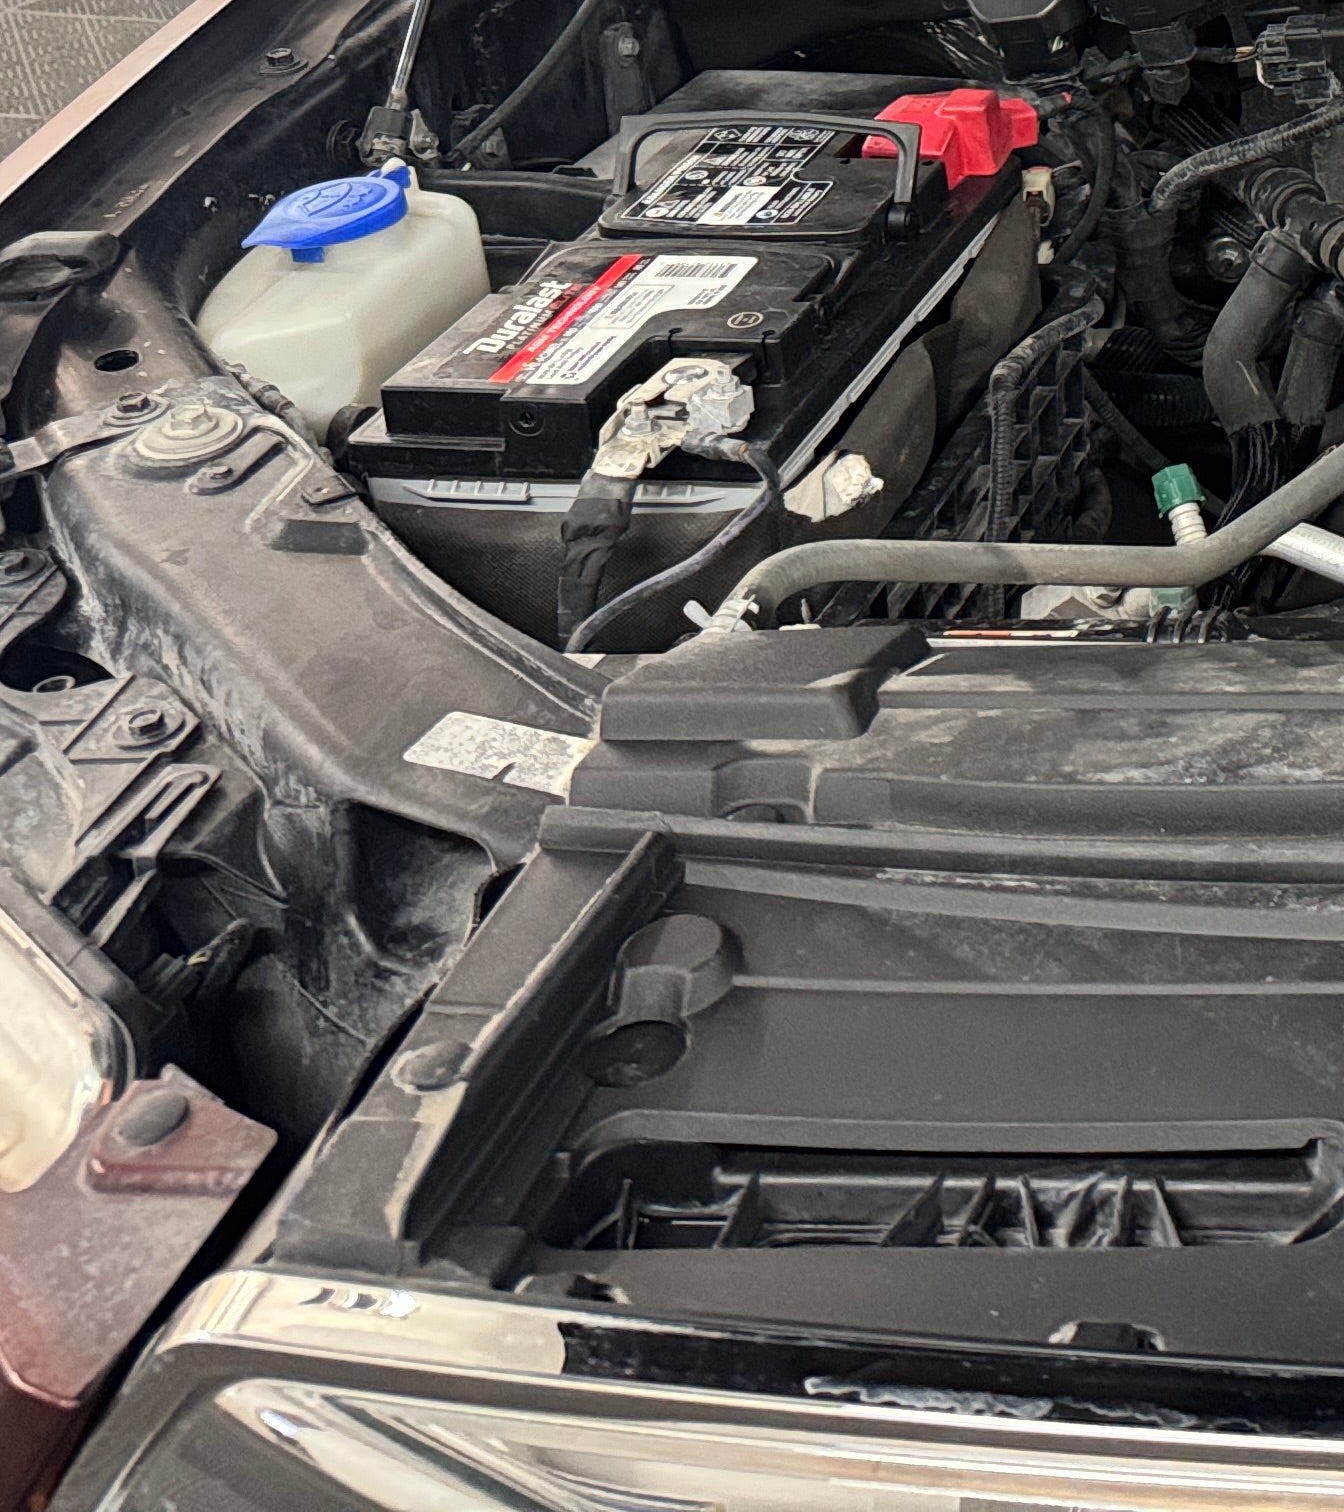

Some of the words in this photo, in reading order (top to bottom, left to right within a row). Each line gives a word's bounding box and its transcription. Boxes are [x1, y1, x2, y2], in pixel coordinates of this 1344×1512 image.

[462, 280, 574, 355] Duralast
[505, 309, 555, 350] PLATINUM
[545, 286, 601, 334] TECHNOLOGY
